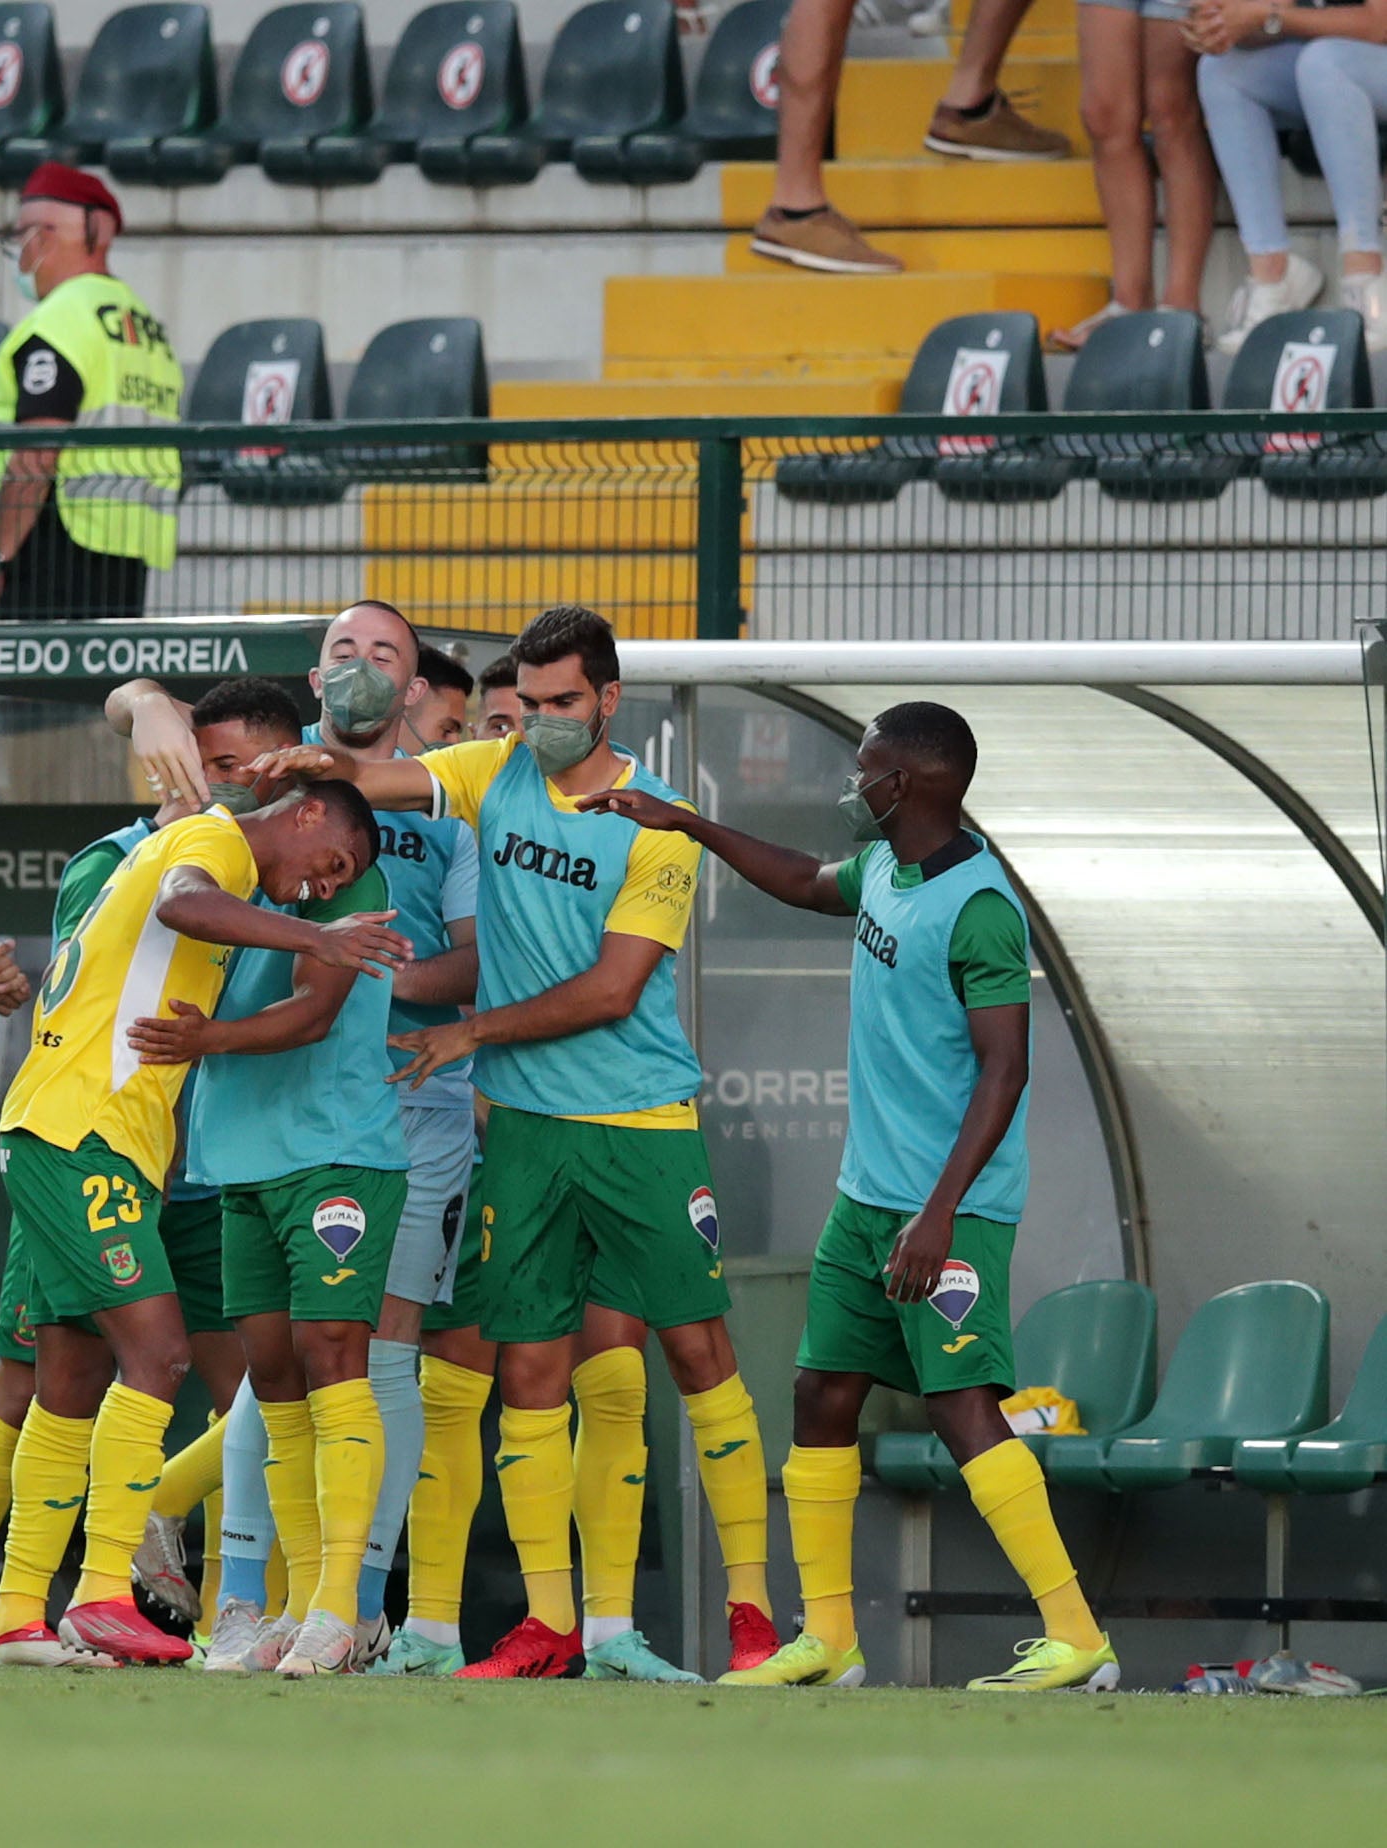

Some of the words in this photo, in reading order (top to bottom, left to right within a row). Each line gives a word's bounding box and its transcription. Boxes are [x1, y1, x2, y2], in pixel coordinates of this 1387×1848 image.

[82, 637, 249, 674] CORREIA
[494, 831, 598, 892] Joma
[854, 904, 898, 969] oma
[82, 1174, 143, 1233] 23
[320, 1211, 360, 1224] RE/MAX
[939, 1276, 973, 1287] E/MAX
